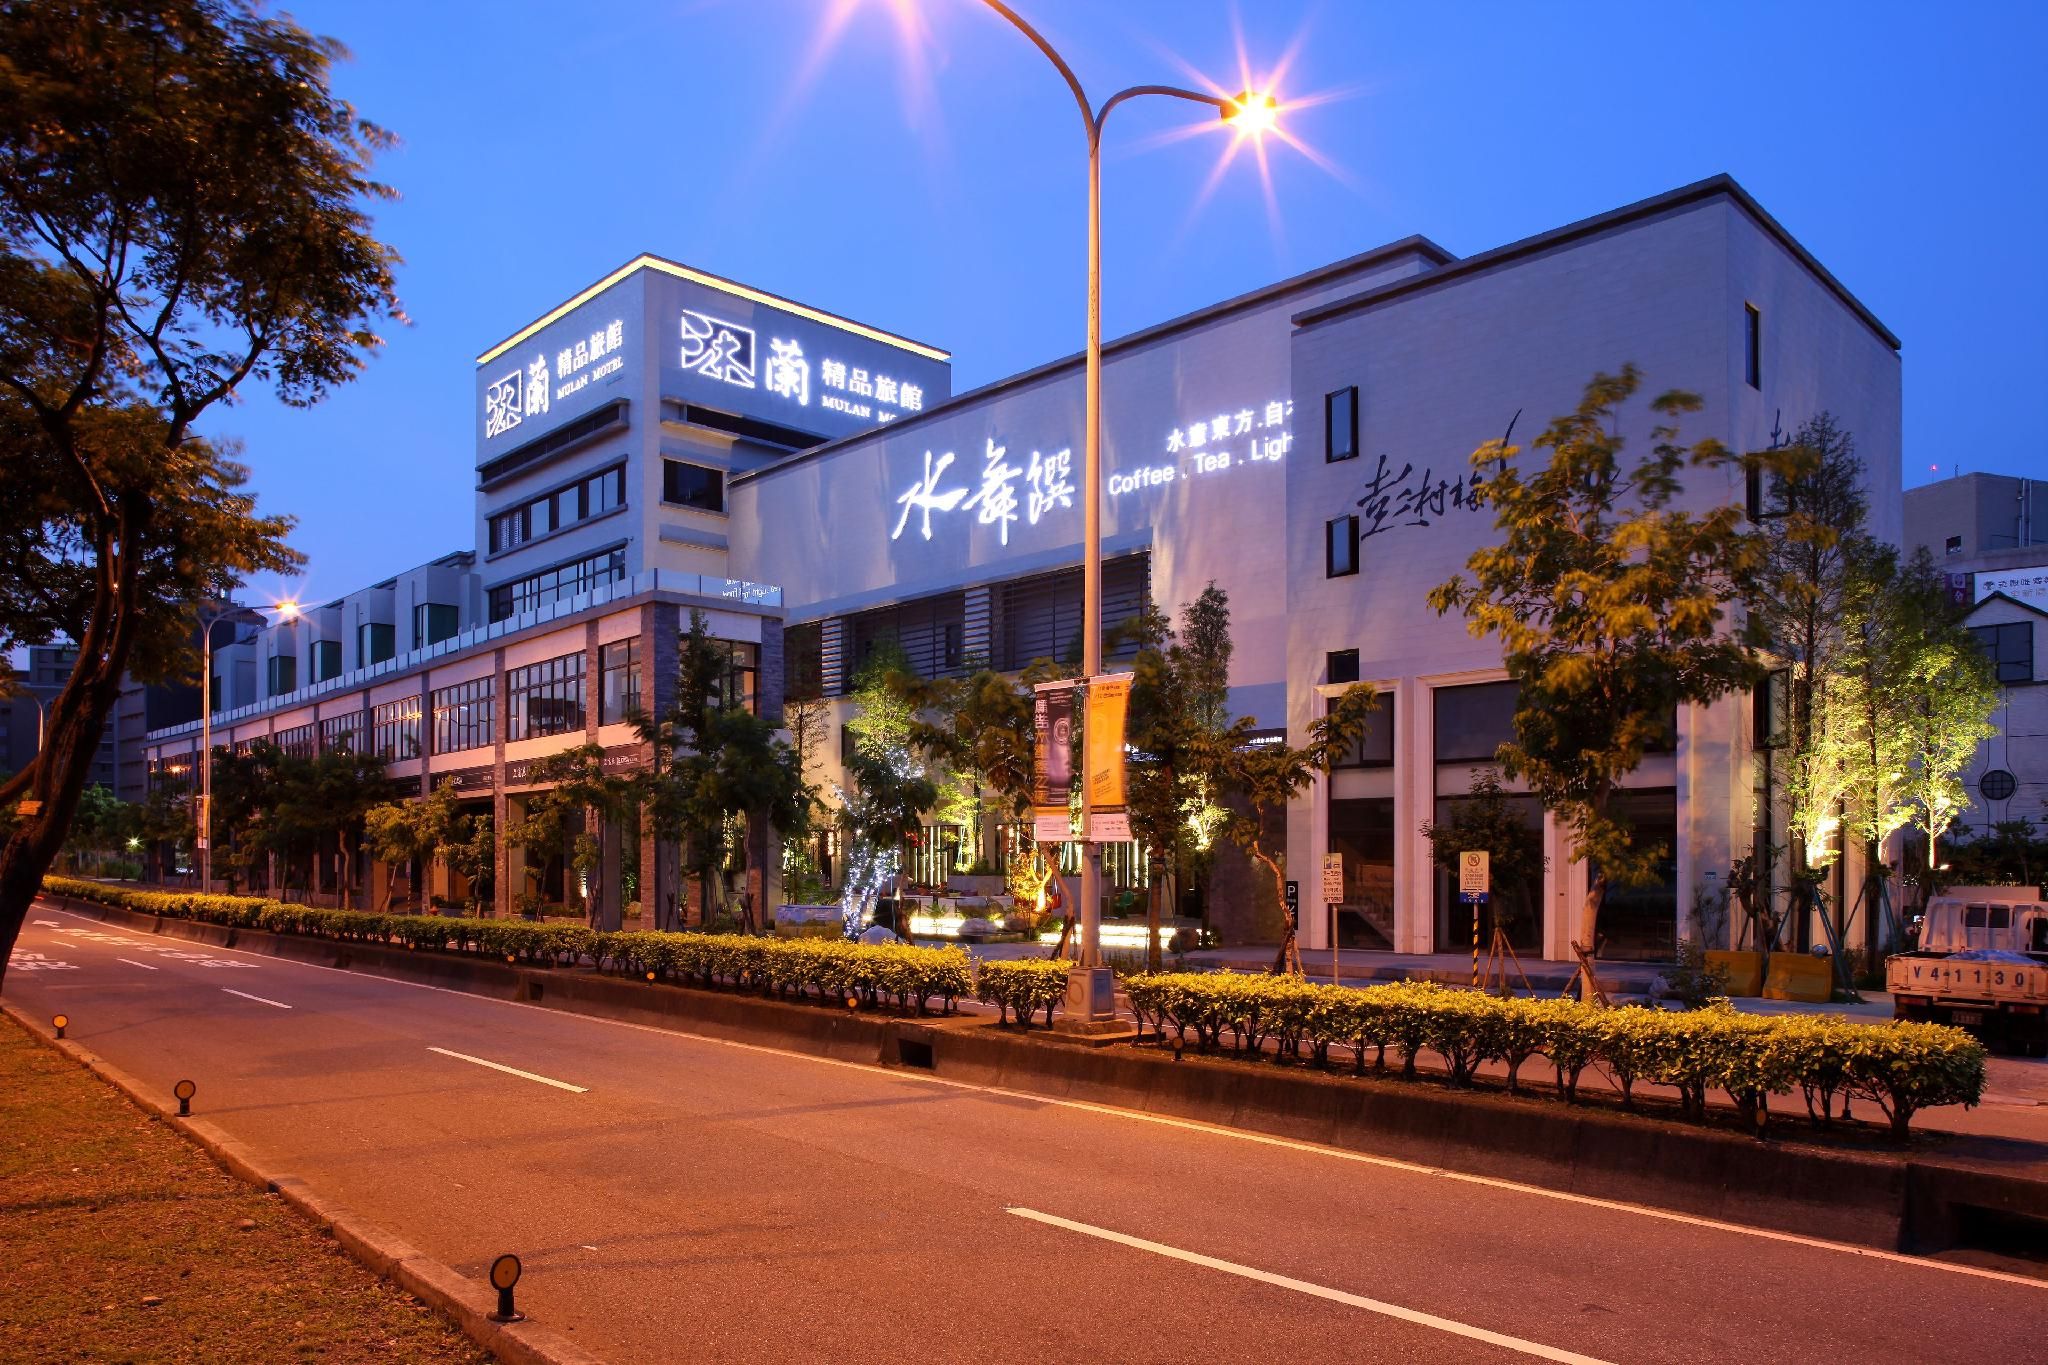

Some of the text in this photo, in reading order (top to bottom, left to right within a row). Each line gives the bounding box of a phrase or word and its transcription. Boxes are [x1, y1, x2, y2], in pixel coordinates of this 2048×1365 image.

[557, 319, 624, 380] 精品旅館
[556, 356, 624, 400] MULAN MOTEL
[822, 357, 923, 411] 精品旅館
[822, 394, 871, 418] MULAN
[1108, 465, 1175, 496] Coffee
[1193, 451, 1230, 474] Tea
